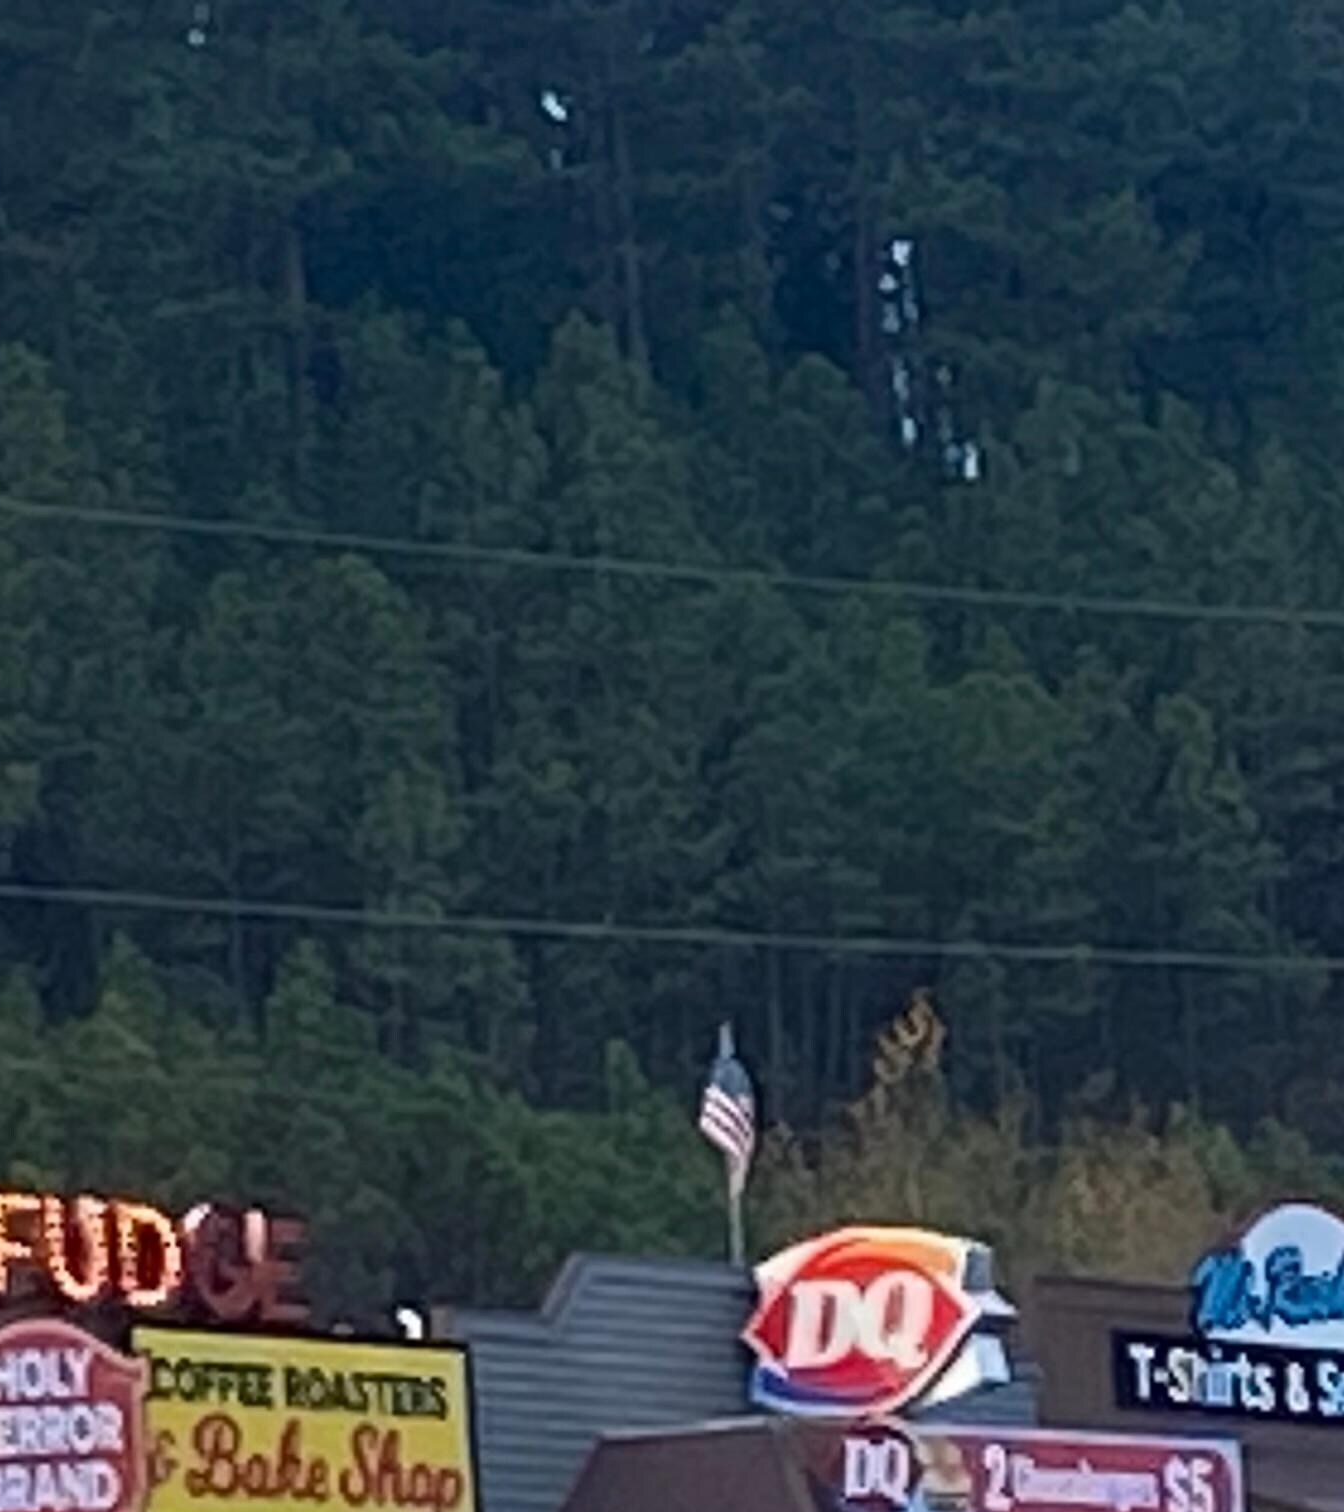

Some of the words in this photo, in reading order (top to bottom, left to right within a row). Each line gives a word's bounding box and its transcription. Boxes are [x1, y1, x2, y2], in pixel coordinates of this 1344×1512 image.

[787, 1269, 934, 1371] DQ
[145, 1356, 274, 1410] COFFEE
[284, 1366, 447, 1421] ROASTERS
[1128, 1343, 1275, 1412] T-Shirts
[1285, 1362, 1310, 1414] &
[185, 1411, 330, 1504] Bake
[843, 1436, 919, 1506] DQ
